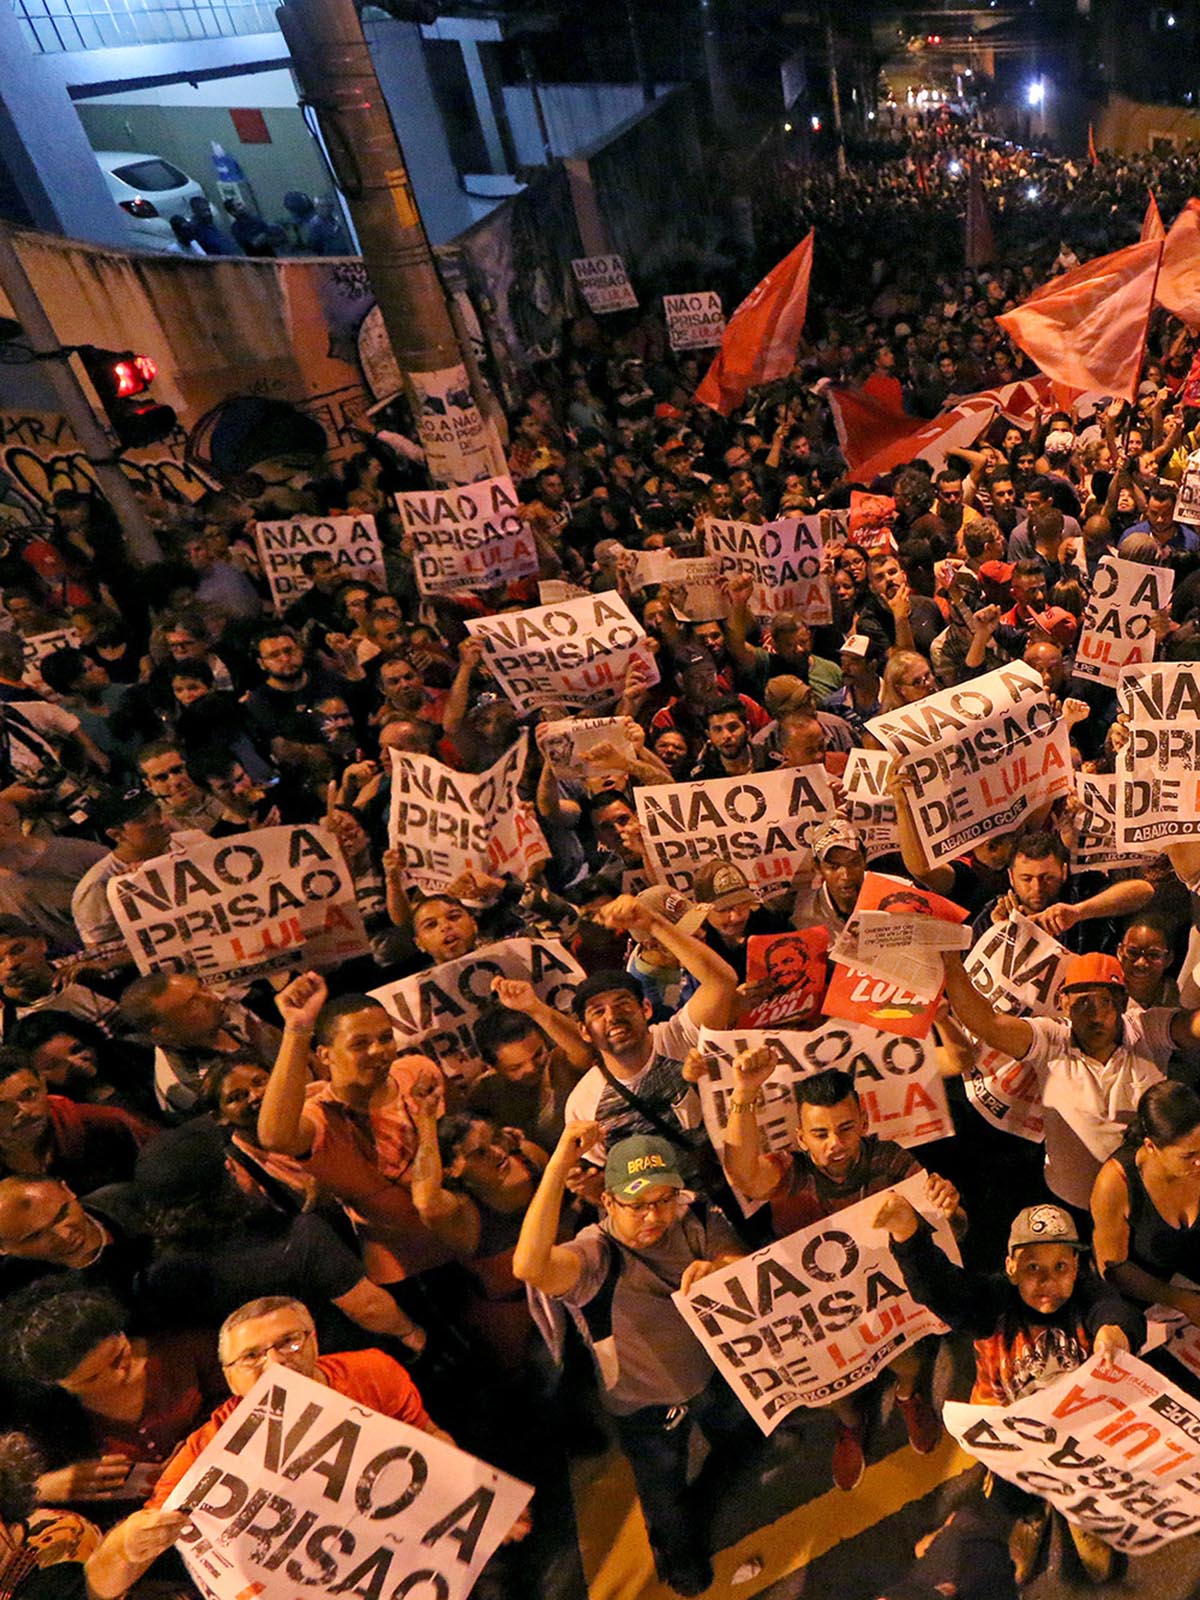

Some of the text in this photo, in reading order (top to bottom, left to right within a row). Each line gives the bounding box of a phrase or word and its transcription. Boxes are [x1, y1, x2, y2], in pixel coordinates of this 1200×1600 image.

[420, 538, 531, 578] DE LULA
[759, 583, 825, 612] LULA
[493, 625, 638, 676] PRISÃO
[507, 651, 650, 697] DE LULA
[1082, 637, 1142, 666] ULA
[585, 717, 617, 730] LULA
[905, 702, 1058, 799] PRISÃO
[644, 783, 767, 837] NÃO
[919, 786, 974, 838] DE
[979, 742, 1066, 808] LULA
[1124, 779, 1180, 819] DE
[654, 819, 824, 868] PRISÃO
[939, 823, 981, 854] ABAIXO
[1133, 823, 1179, 841] ABAIXO
[1182, 823, 1194, 833] O
[116, 845, 264, 922] NÃO
[397, 841, 452, 877] DE
[136, 869, 342, 957] PRISÃO
[230, 904, 355, 962] LULA
[754, 991, 814, 1027] LULA
[702, 1030, 853, 1082] NÃO
[690, 1230, 860, 1338] NÃO
[717, 1263, 908, 1368] PRISÃ
[739, 1304, 927, 1400] DE LUL
[773, 1340, 897, 1410] ABAIXO O GOLPE
[223, 1384, 429, 1521] NÃO
[1051, 1384, 1196, 1476] LULA
